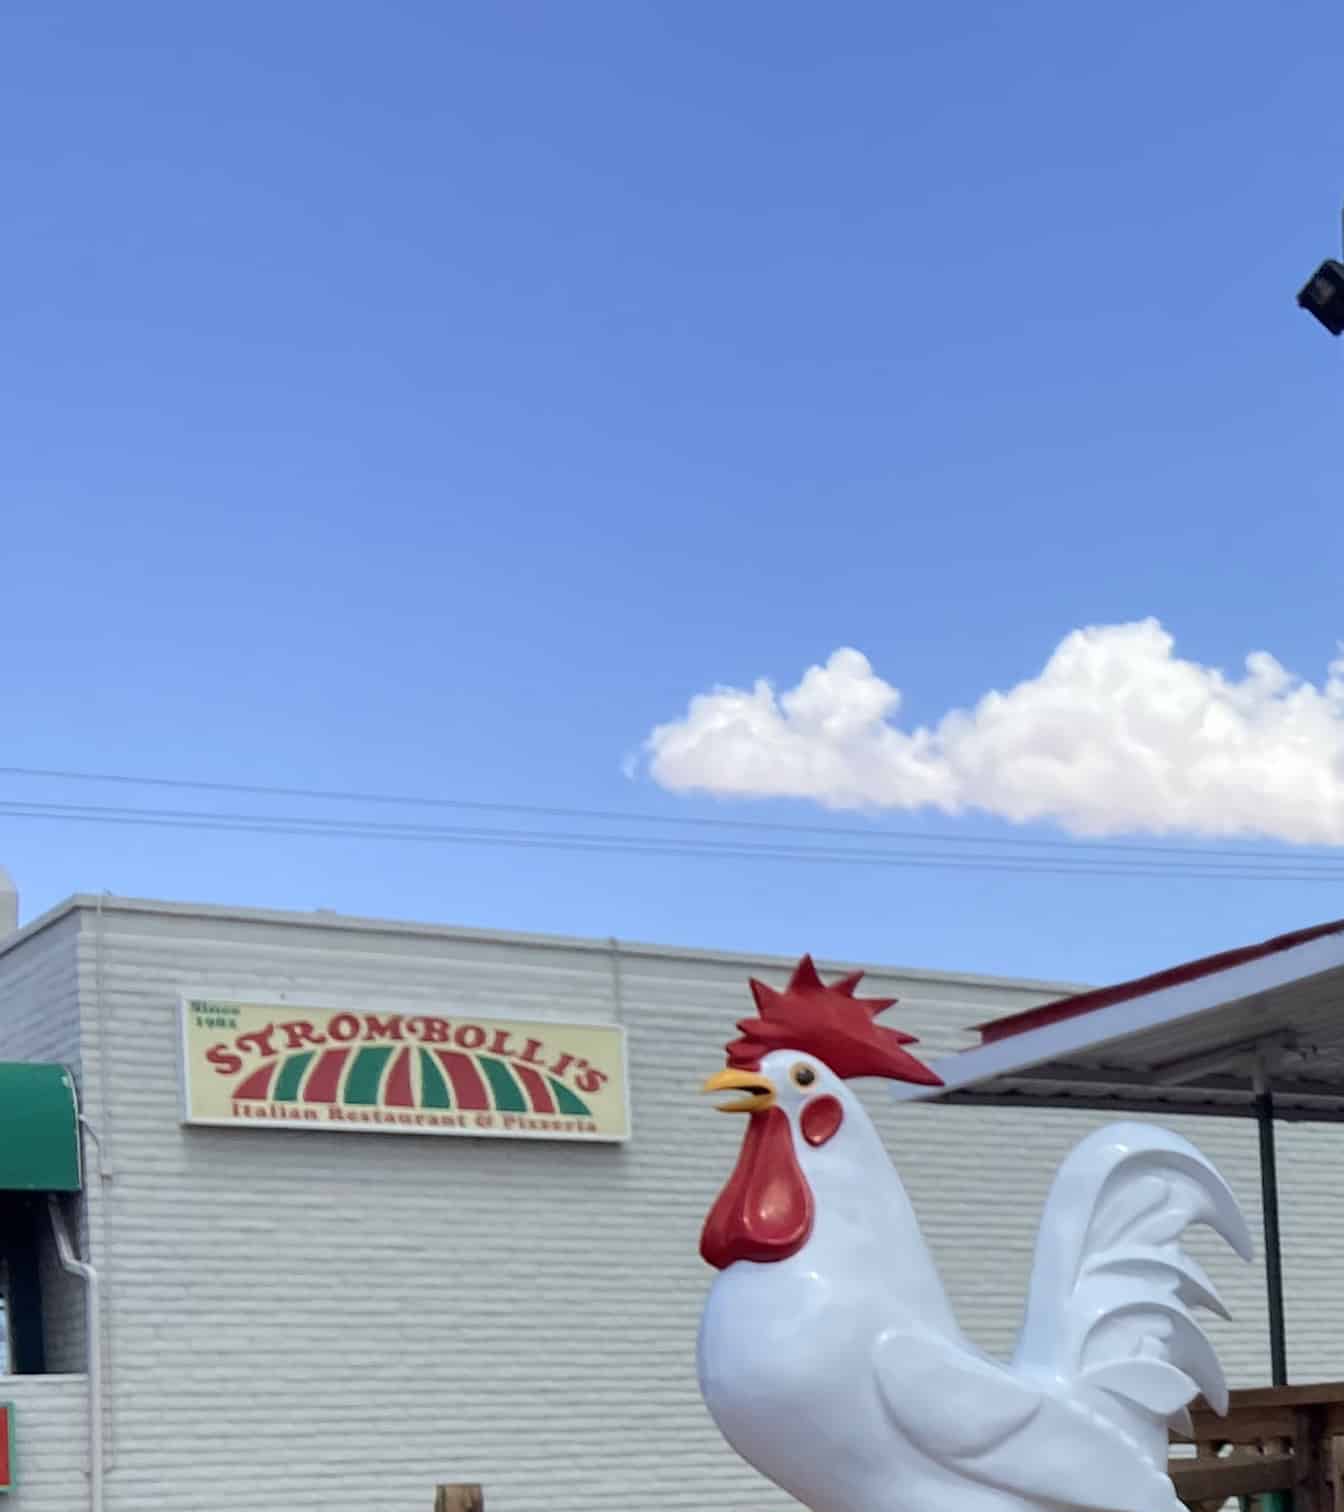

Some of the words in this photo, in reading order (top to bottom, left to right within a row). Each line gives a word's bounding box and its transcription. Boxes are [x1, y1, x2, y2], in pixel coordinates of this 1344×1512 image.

[205, 1011, 608, 1095] STROMBOLLI'S
[231, 1102, 319, 1122] Italian
[327, 1106, 466, 1130] Restaurant
[503, 1115, 598, 1135] Pizzeria
